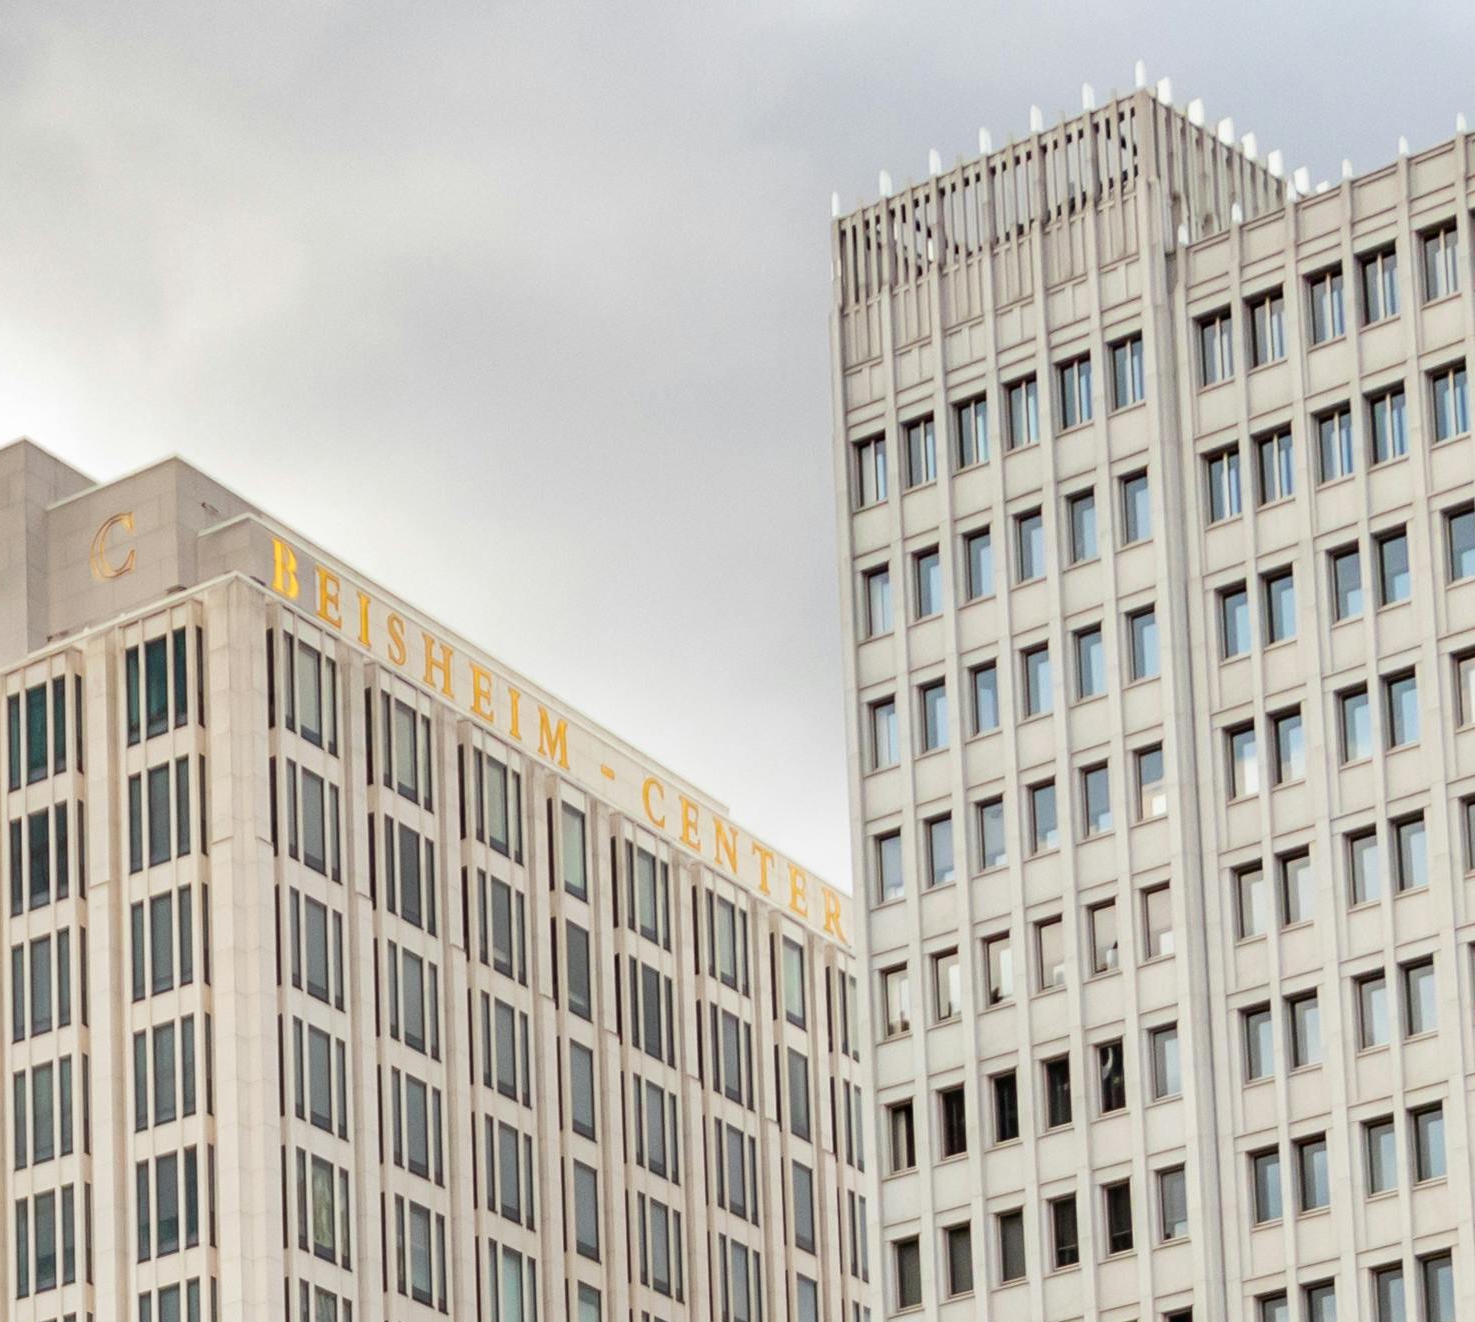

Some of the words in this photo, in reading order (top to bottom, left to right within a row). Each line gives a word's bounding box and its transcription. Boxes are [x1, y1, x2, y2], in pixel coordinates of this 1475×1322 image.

[89, 511, 137, 580] C
[271, 537, 571, 771] BEISHEIM
[641, 776, 848, 945] CENTER
